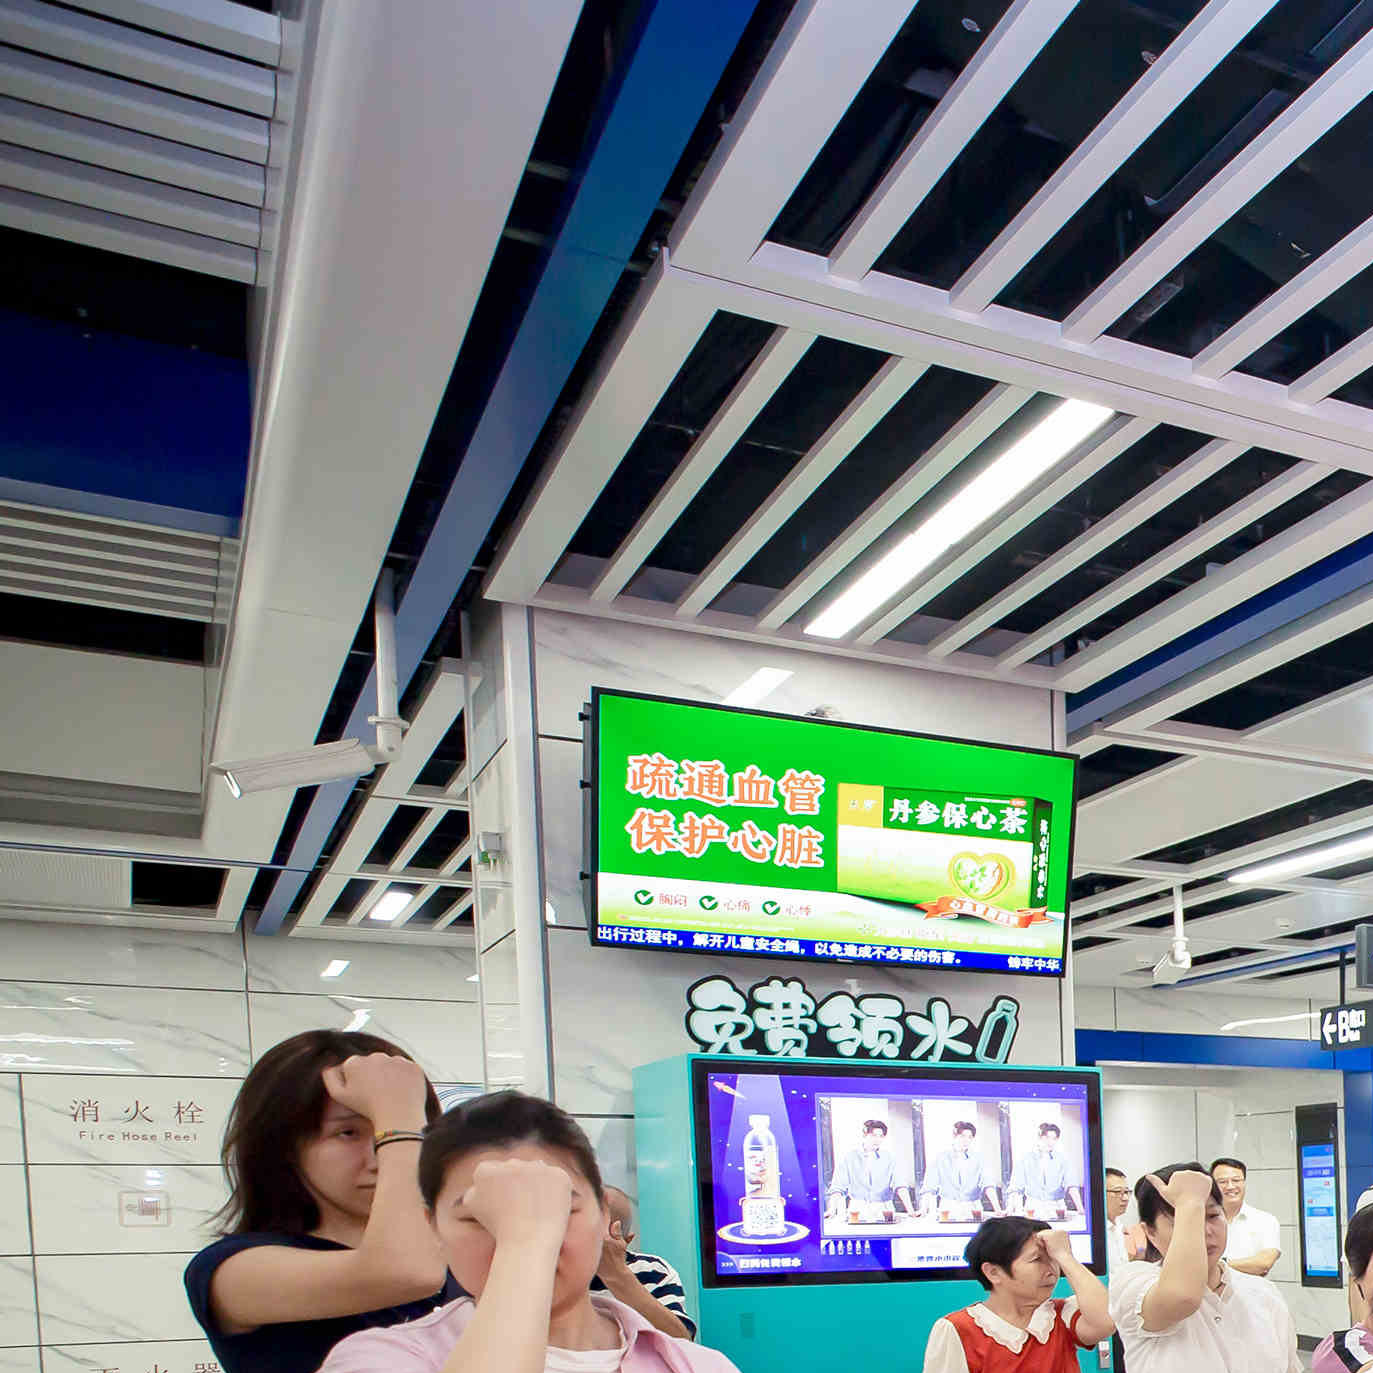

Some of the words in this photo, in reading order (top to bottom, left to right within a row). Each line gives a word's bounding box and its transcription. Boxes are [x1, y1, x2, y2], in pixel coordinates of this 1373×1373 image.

[626, 753, 825, 815] 疏通血管
[625, 808, 825, 868] 保护心脏
[889, 798, 1028, 834] 丹参保心茶
[687, 977, 973, 1062] 免费领水
[70, 1099, 205, 1124] 消火栓
[79, 1130, 115, 1141] Fire
[122, 1131, 158, 1142] Hose
